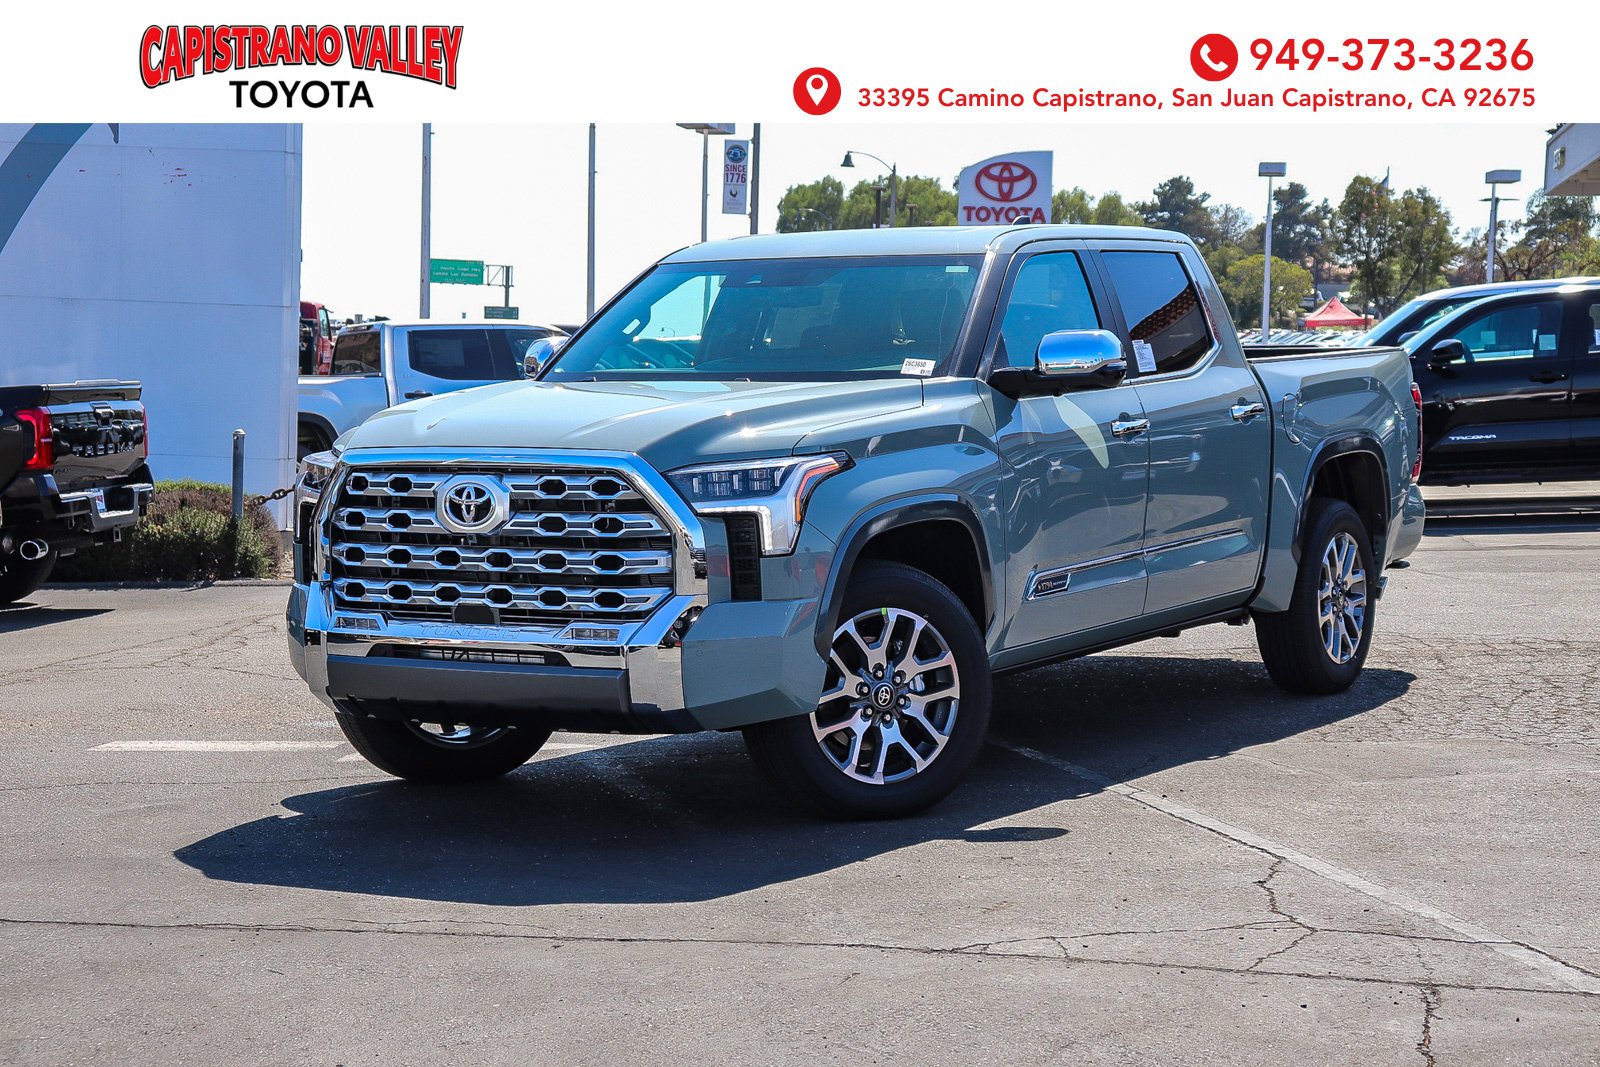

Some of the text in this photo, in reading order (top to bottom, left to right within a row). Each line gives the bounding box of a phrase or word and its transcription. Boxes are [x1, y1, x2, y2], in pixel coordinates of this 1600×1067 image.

[725, 164, 747, 173] SINCE
[725, 173, 746, 184] 1776
[963, 205, 1047, 223] TOYOTA
[420, 624, 521, 640] TUNDRA
